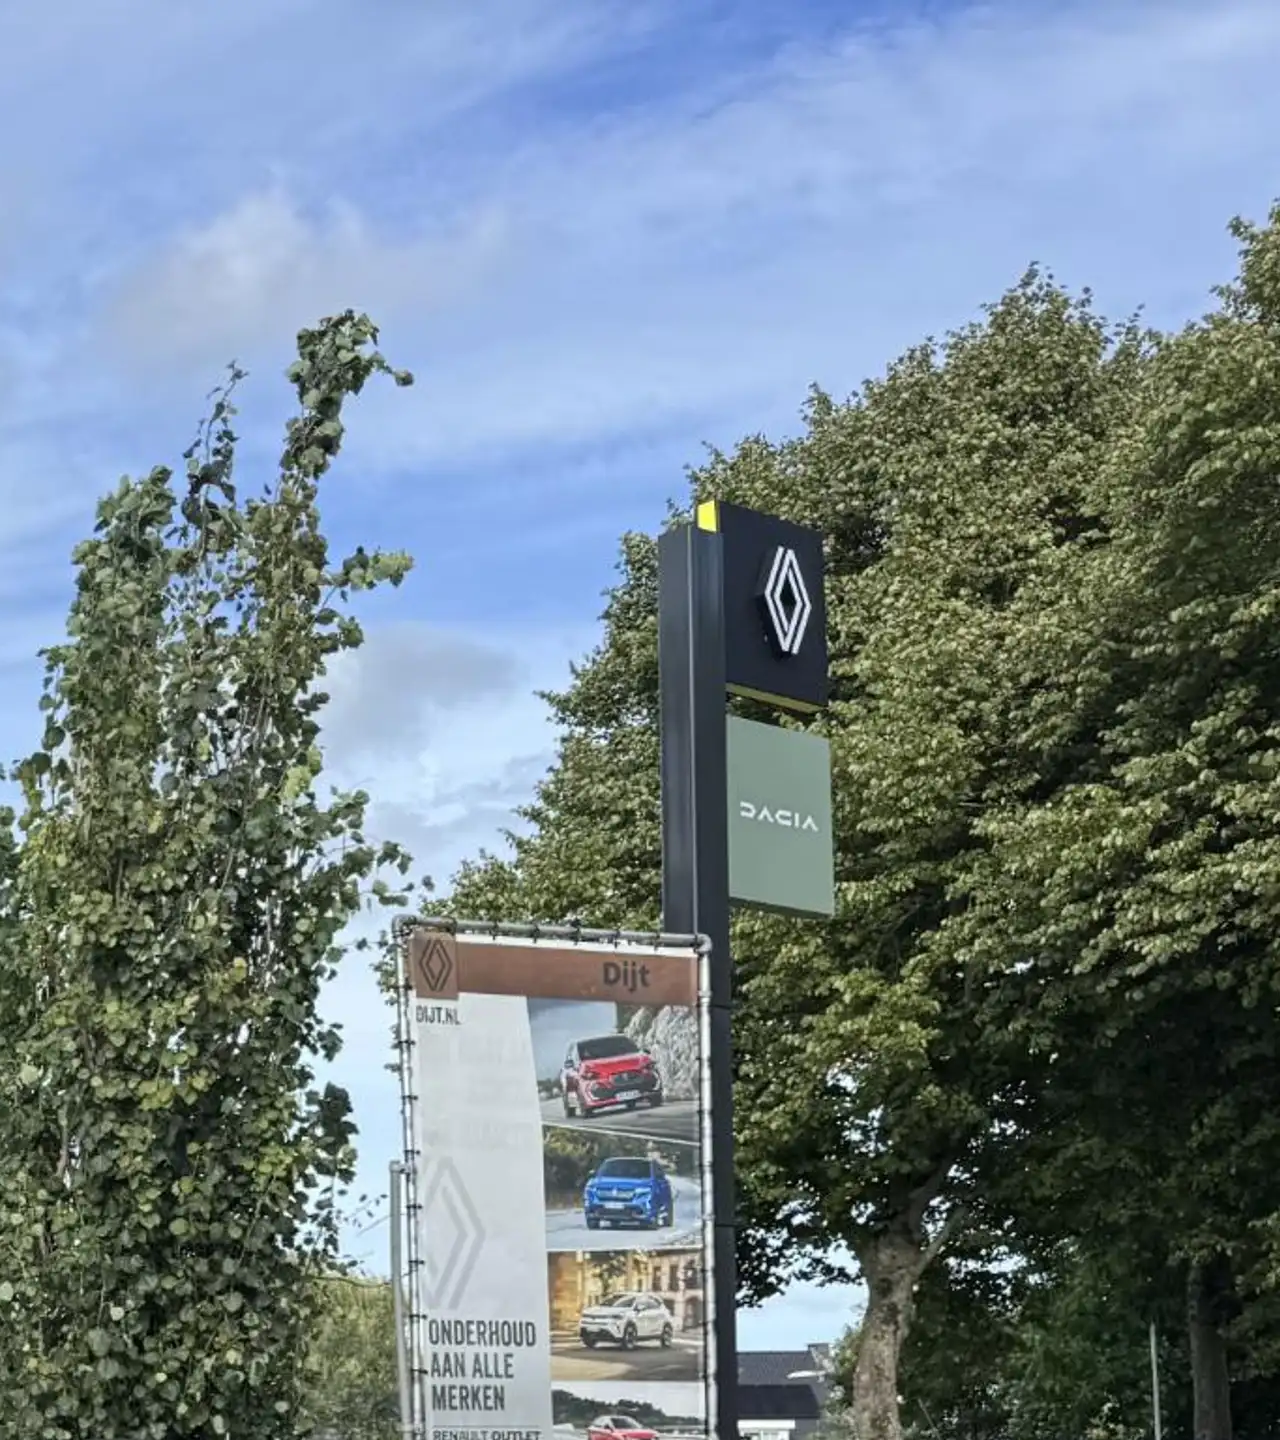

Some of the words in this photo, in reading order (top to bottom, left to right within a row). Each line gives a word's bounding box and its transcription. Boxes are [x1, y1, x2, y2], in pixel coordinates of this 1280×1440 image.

[740, 801, 819, 832] DACIA
[603, 961, 650, 991] Dijt
[416, 1005, 461, 1025] DIJT.NL
[429, 1319, 537, 1347] ONDERHOUD
[430, 1351, 466, 1379] AAN
[472, 1352, 515, 1379] ALLE
[432, 1384, 505, 1411] MERKEN
